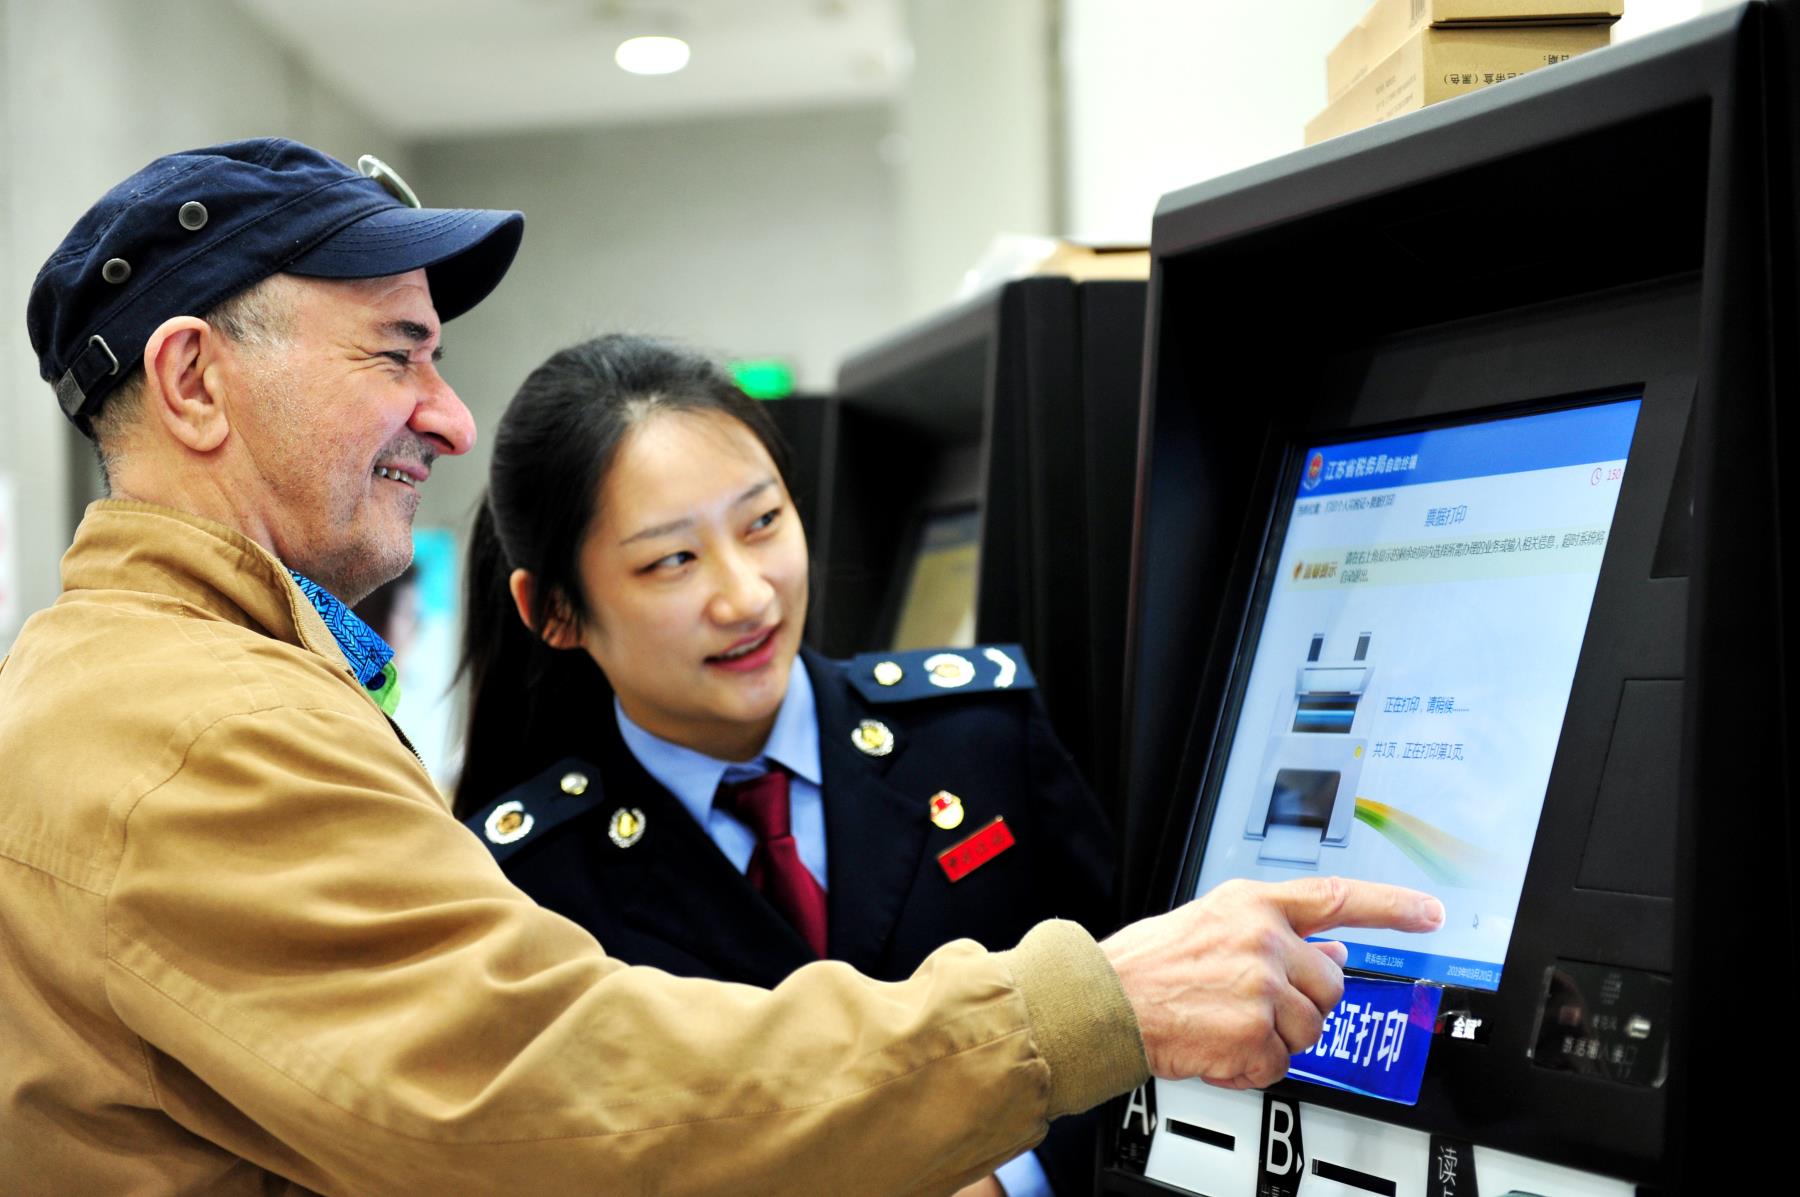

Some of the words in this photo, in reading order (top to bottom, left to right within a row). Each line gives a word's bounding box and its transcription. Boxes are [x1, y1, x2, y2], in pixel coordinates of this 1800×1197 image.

[1444, 72, 1525, 85] 色带盒（黑色）
[1424, 504, 1468, 527] 票据打印
[1122, 1084, 1150, 1136] A
[1266, 1100, 1294, 1176] B
[1437, 1145, 1458, 1197] 读
